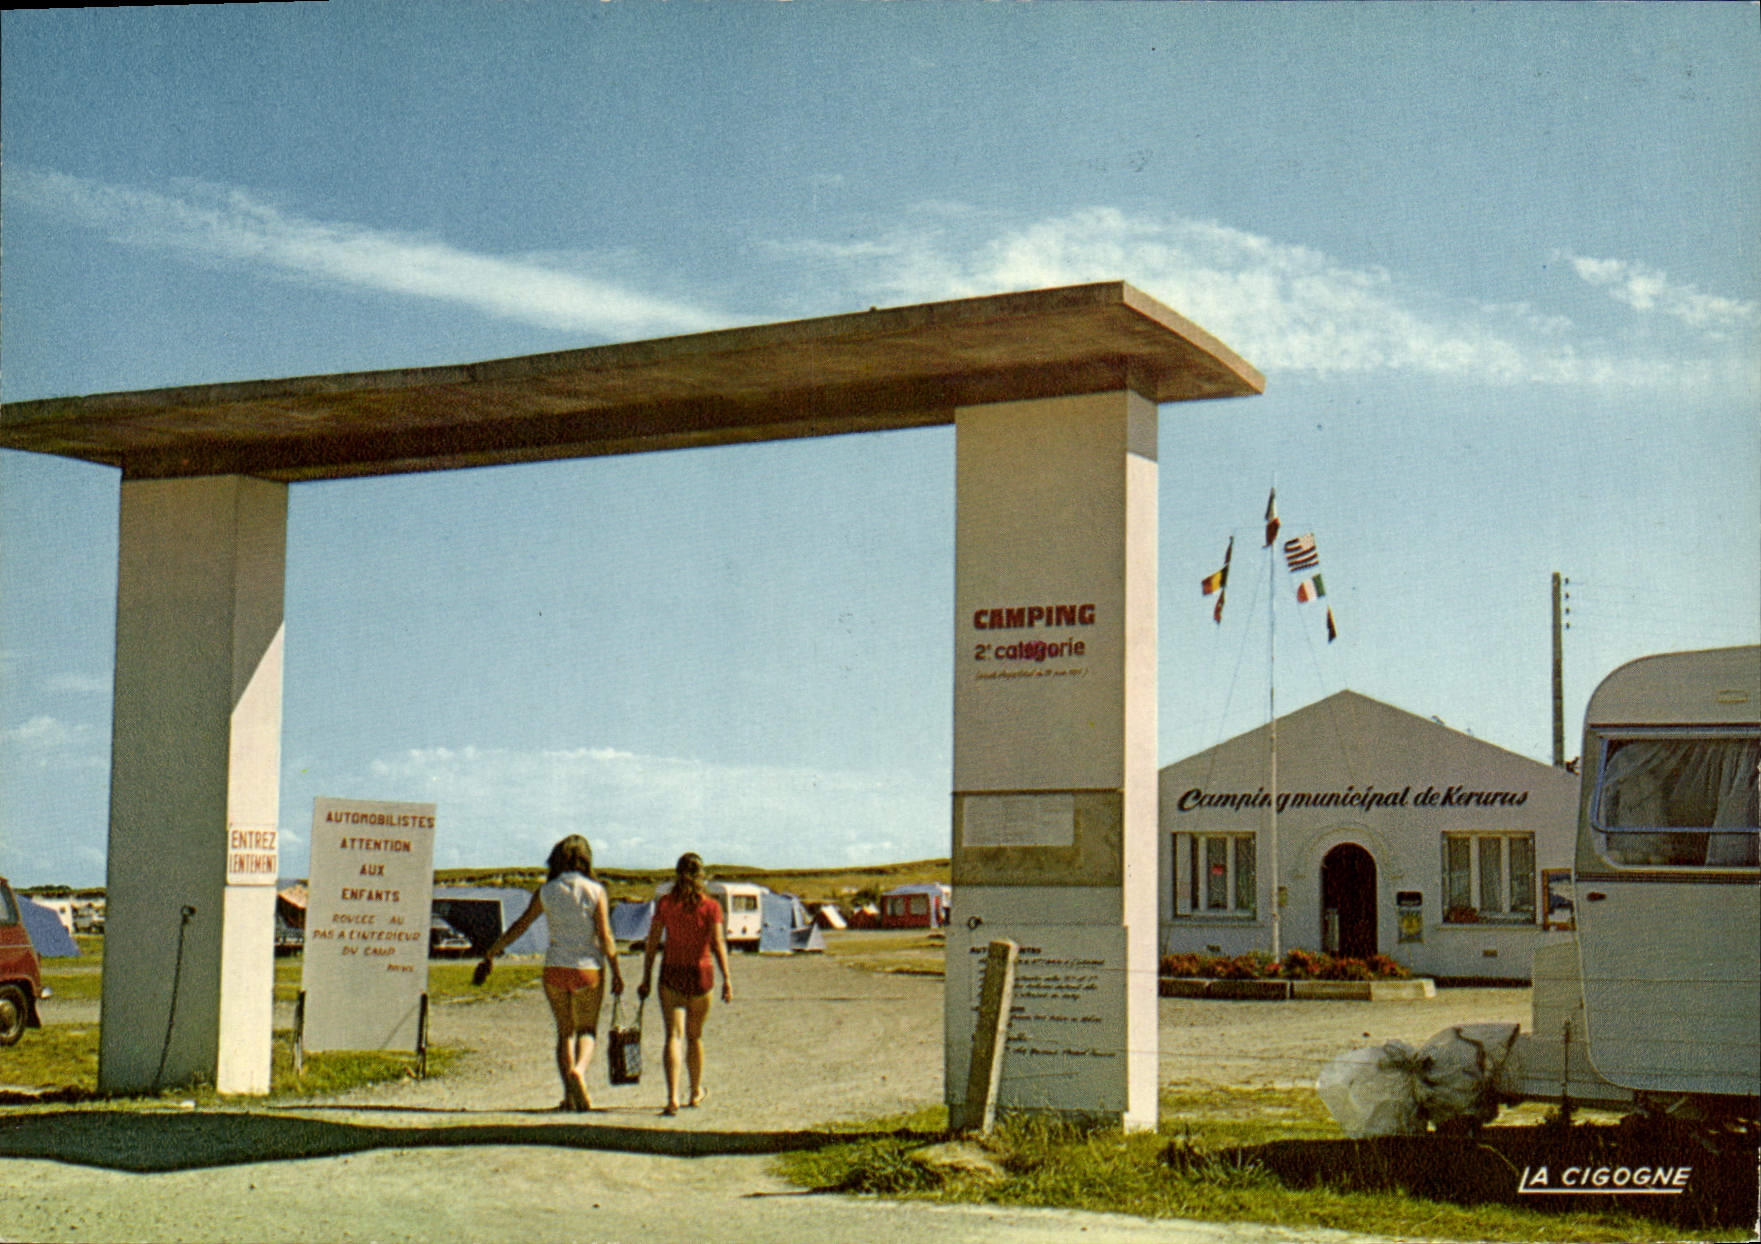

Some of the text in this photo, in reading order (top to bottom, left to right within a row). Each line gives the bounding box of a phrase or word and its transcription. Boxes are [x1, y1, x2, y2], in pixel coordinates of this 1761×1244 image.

[974, 604, 1095, 630] CAMPING
[1177, 785, 1529, 813] Camping municipal de Kerurus
[326, 811, 435, 828] AUTOMOBILISTES
[231, 830, 276, 850] ENTREZ
[340, 837, 411, 852] ATTENTION
[229, 854, 276, 873] LENTEMENT
[360, 864, 384, 876] AUX
[341, 887, 400, 902] ENFANTS
[389, 916, 405, 925] AU
[313, 929, 334, 939] PAS
[342, 946, 359, 955] DU
